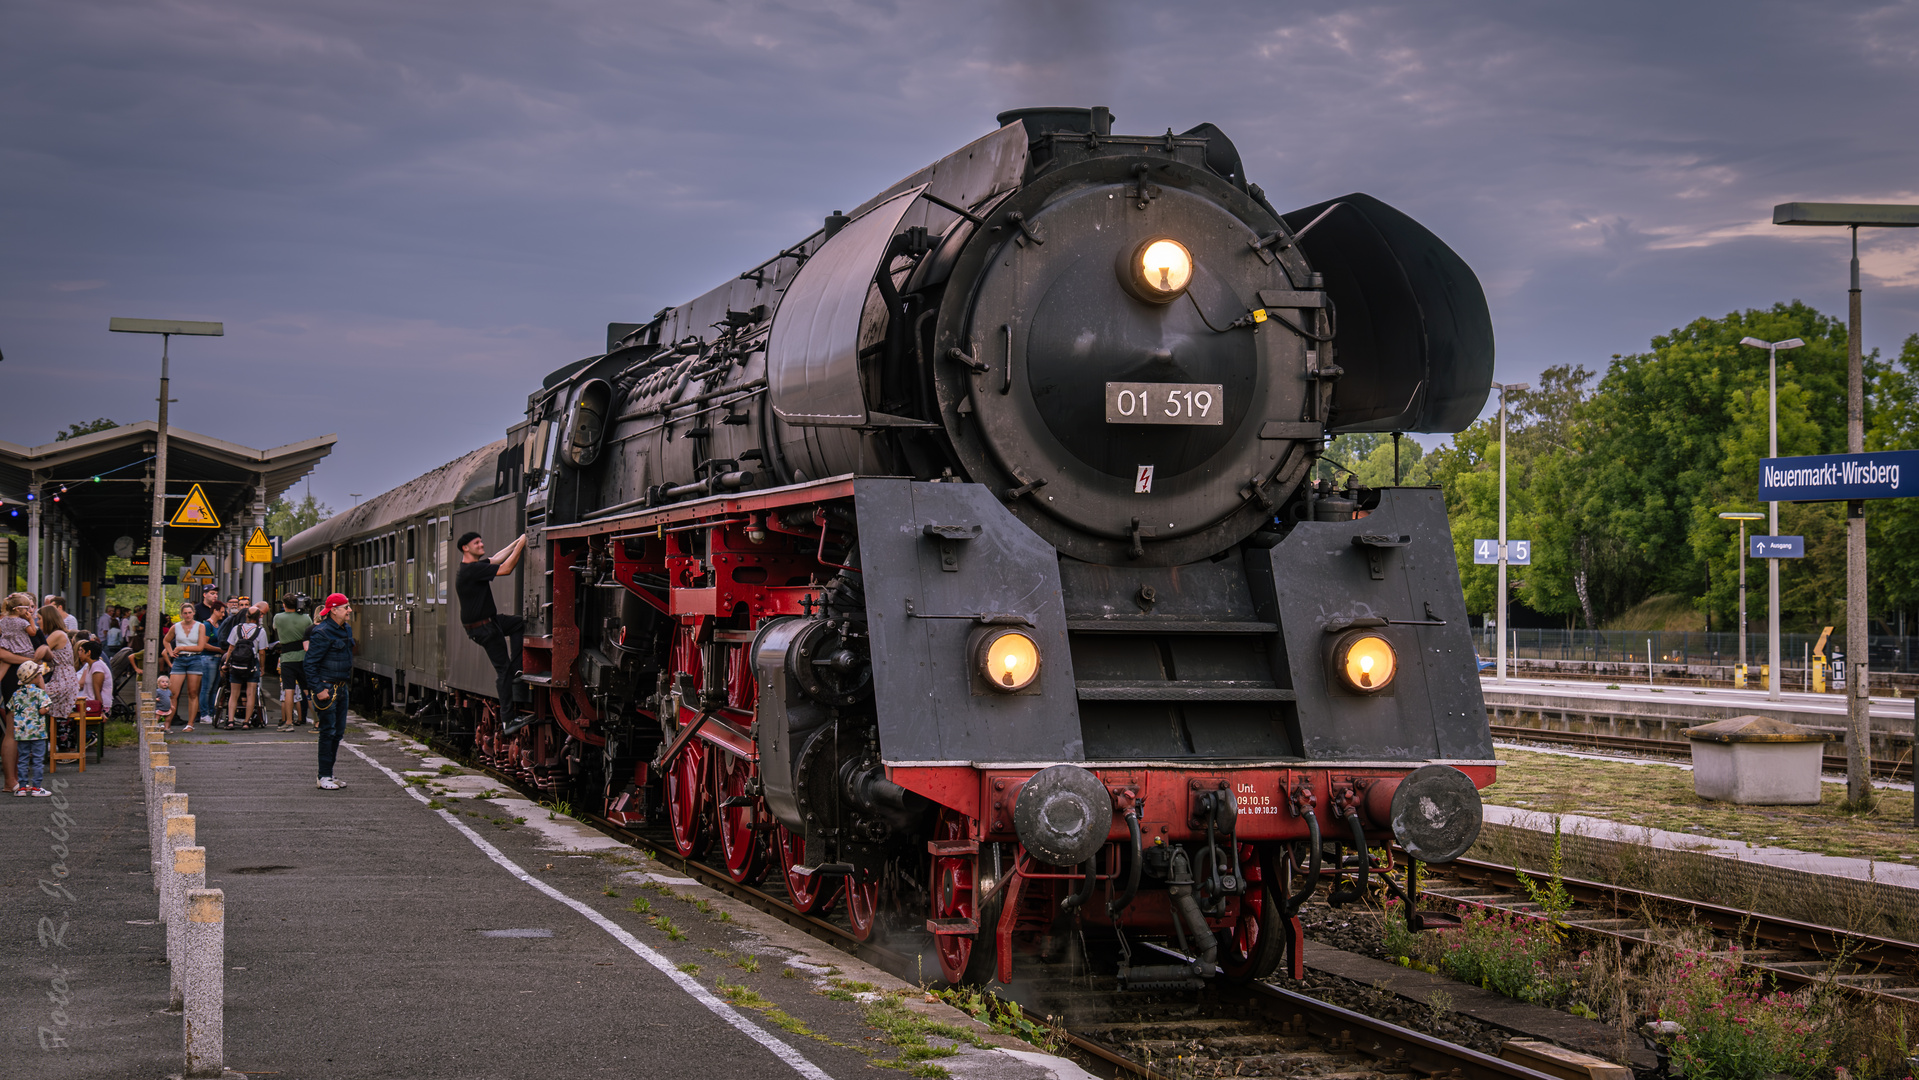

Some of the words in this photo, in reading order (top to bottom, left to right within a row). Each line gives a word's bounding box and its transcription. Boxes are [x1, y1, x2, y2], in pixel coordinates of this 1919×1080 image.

[1117, 390, 1148, 416] 01
[1164, 390, 1212, 417] 519
[1764, 460, 1900, 490] Neuenmarkt-Wirsberg
[269, 536, 279, 557] 1
[1478, 540, 1490, 559] 4
[1516, 541, 1527, 560] 5
[1770, 542, 1792, 550] Ausgang
[1833, 662, 1844, 679] H
[1237, 783, 1256, 793] Unt.
[1237, 796, 1270, 805] 09.10.15
[1254, 806, 1278, 815] 09.10.23
